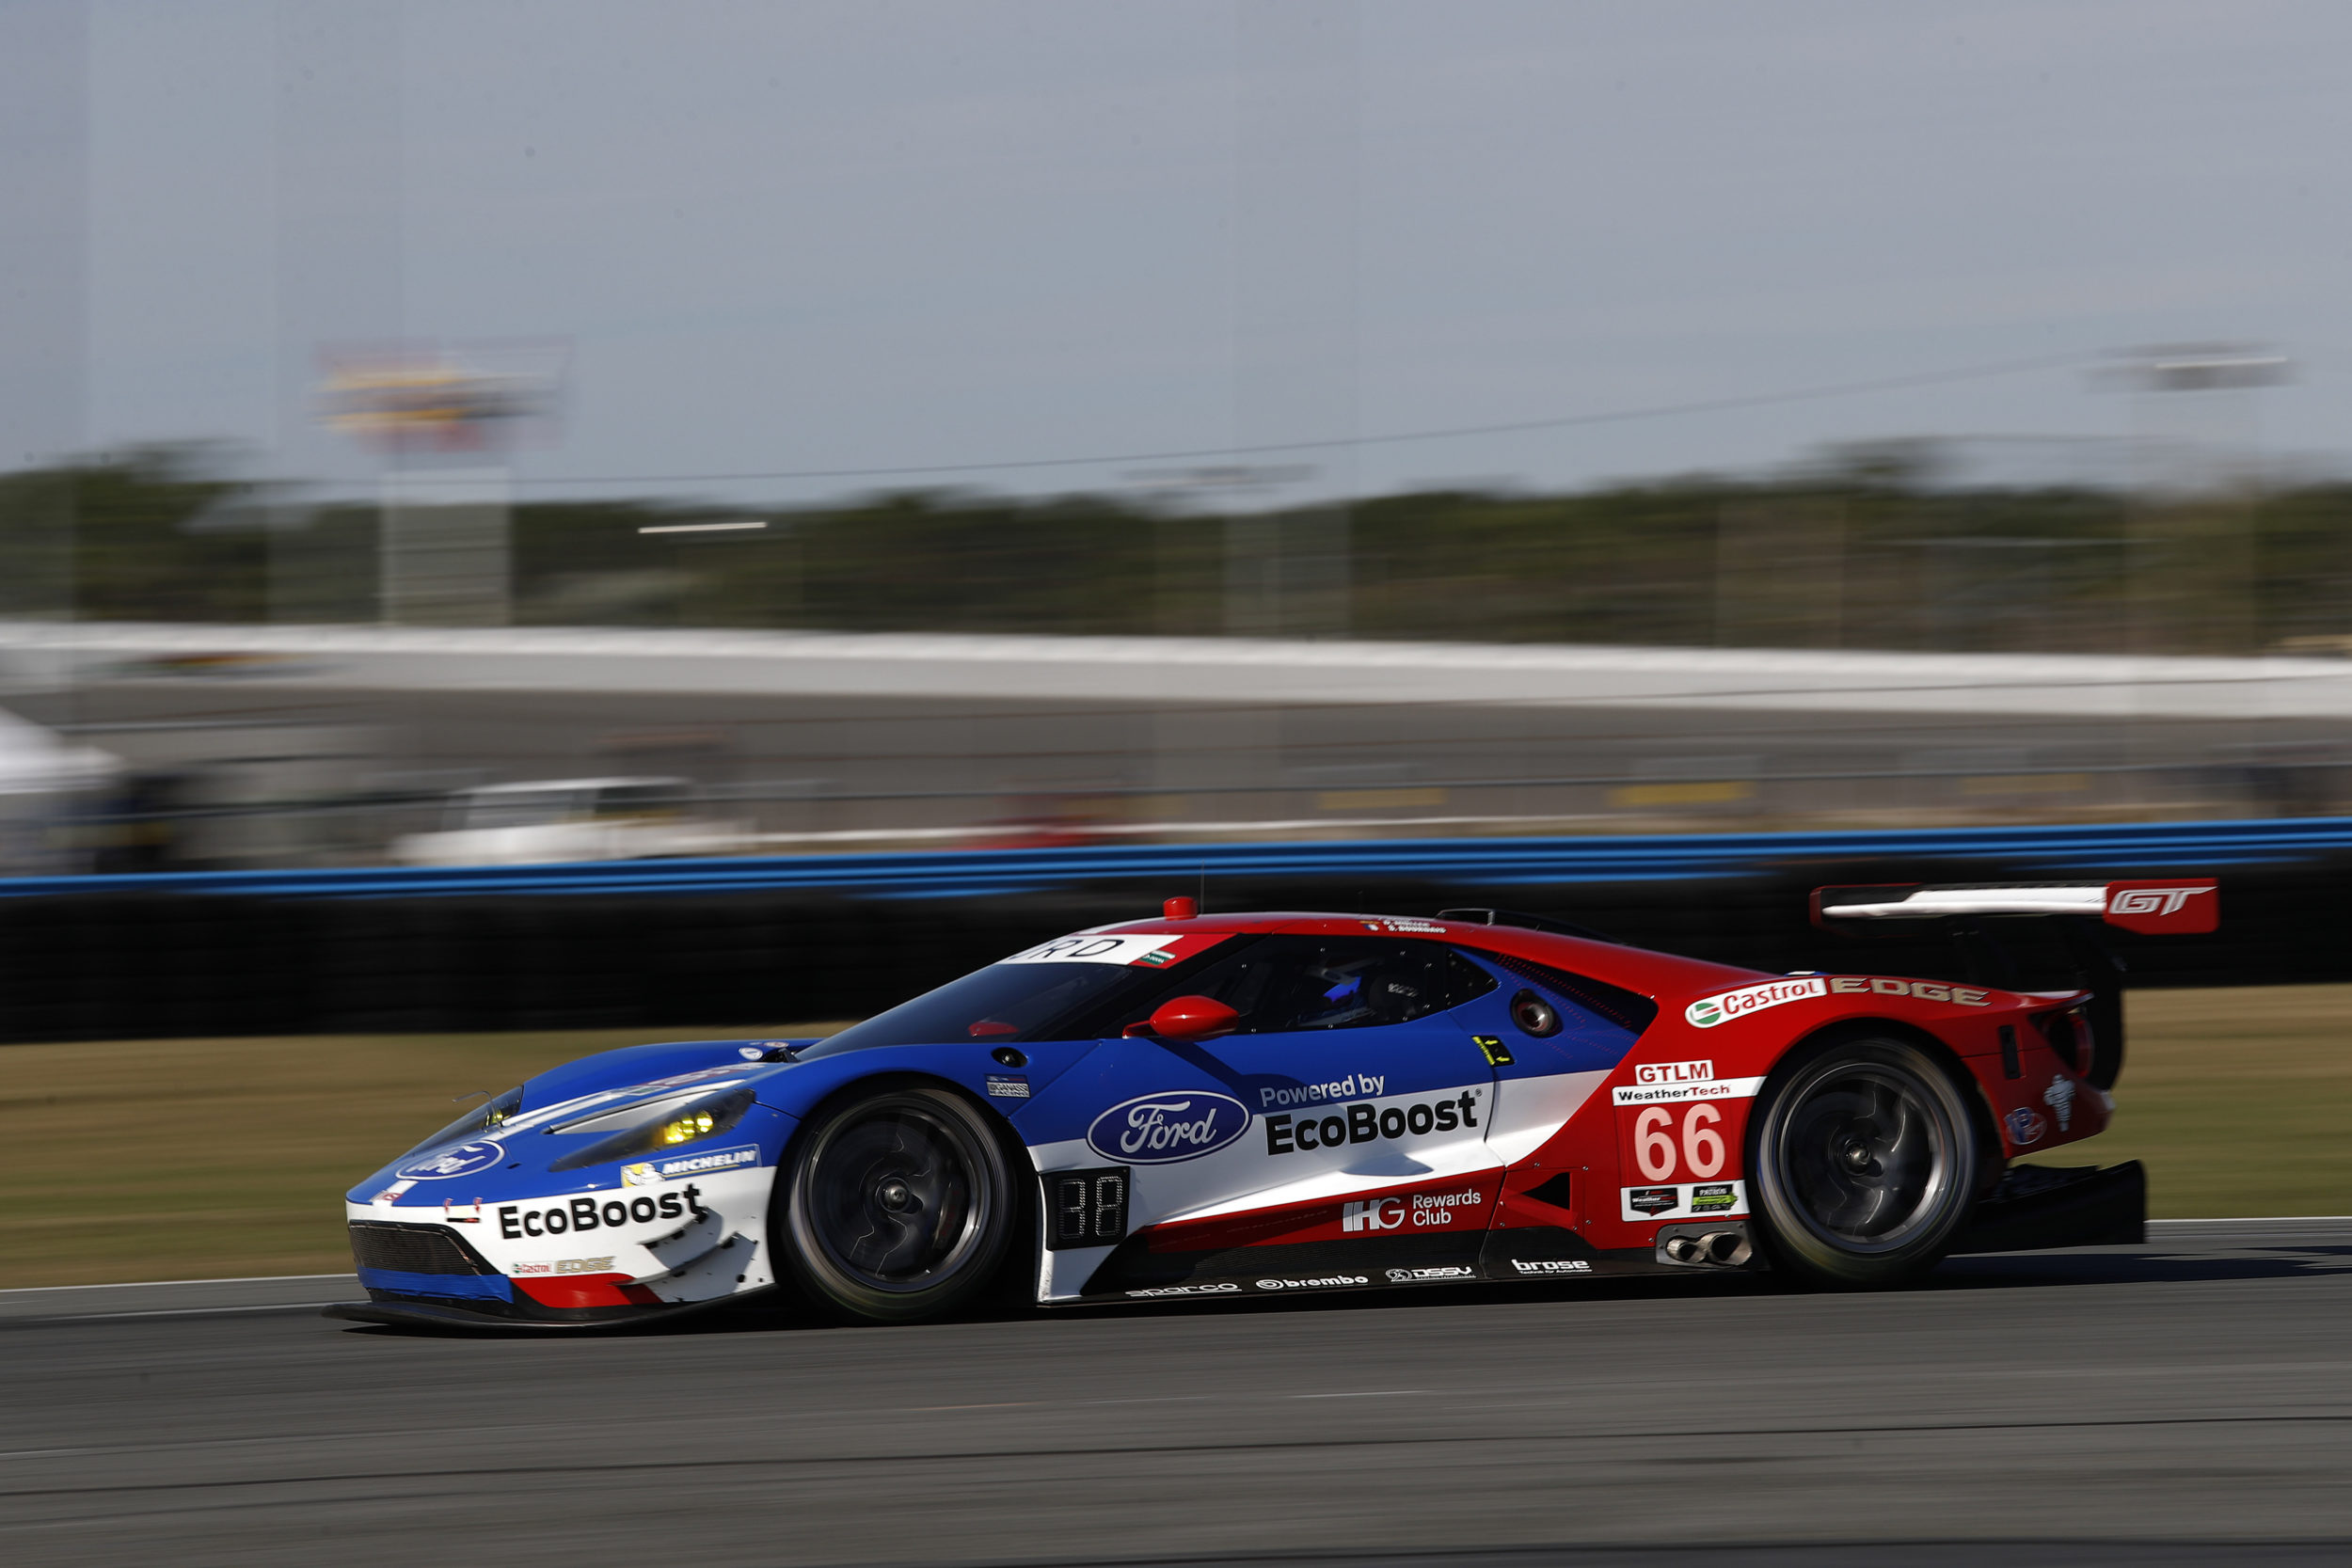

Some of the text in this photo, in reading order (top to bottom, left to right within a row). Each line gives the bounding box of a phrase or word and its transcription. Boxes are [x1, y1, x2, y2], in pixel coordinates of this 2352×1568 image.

[2108, 886, 2217, 917] GT
[1723, 976, 1992, 1016] Castrol EDGE
[1639, 1062, 1709, 1083] GTLM
[1259, 1073, 1386, 1108] Powered by
[1618, 1085, 1730, 1101] WeatherTech
[1120, 1101, 1217, 1154] Ford
[1264, 1089, 1478, 1156] EcoBoost
[1634, 1102, 1726, 1182] 66
[661, 1148, 757, 1175] MICHELIN
[499, 1182, 706, 1240] EcoBoost
[1412, 1187, 1482, 1210] Rewards
[1343, 1196, 1406, 1232] IHG
[1412, 1209, 1453, 1227] Club
[556, 1256, 616, 1275] EDGE
[1411, 1266, 1472, 1277] DSSV
[1511, 1259, 1591, 1272] brose
[1125, 1283, 1243, 1297] sparco
[1283, 1275, 1369, 1289] brembo
